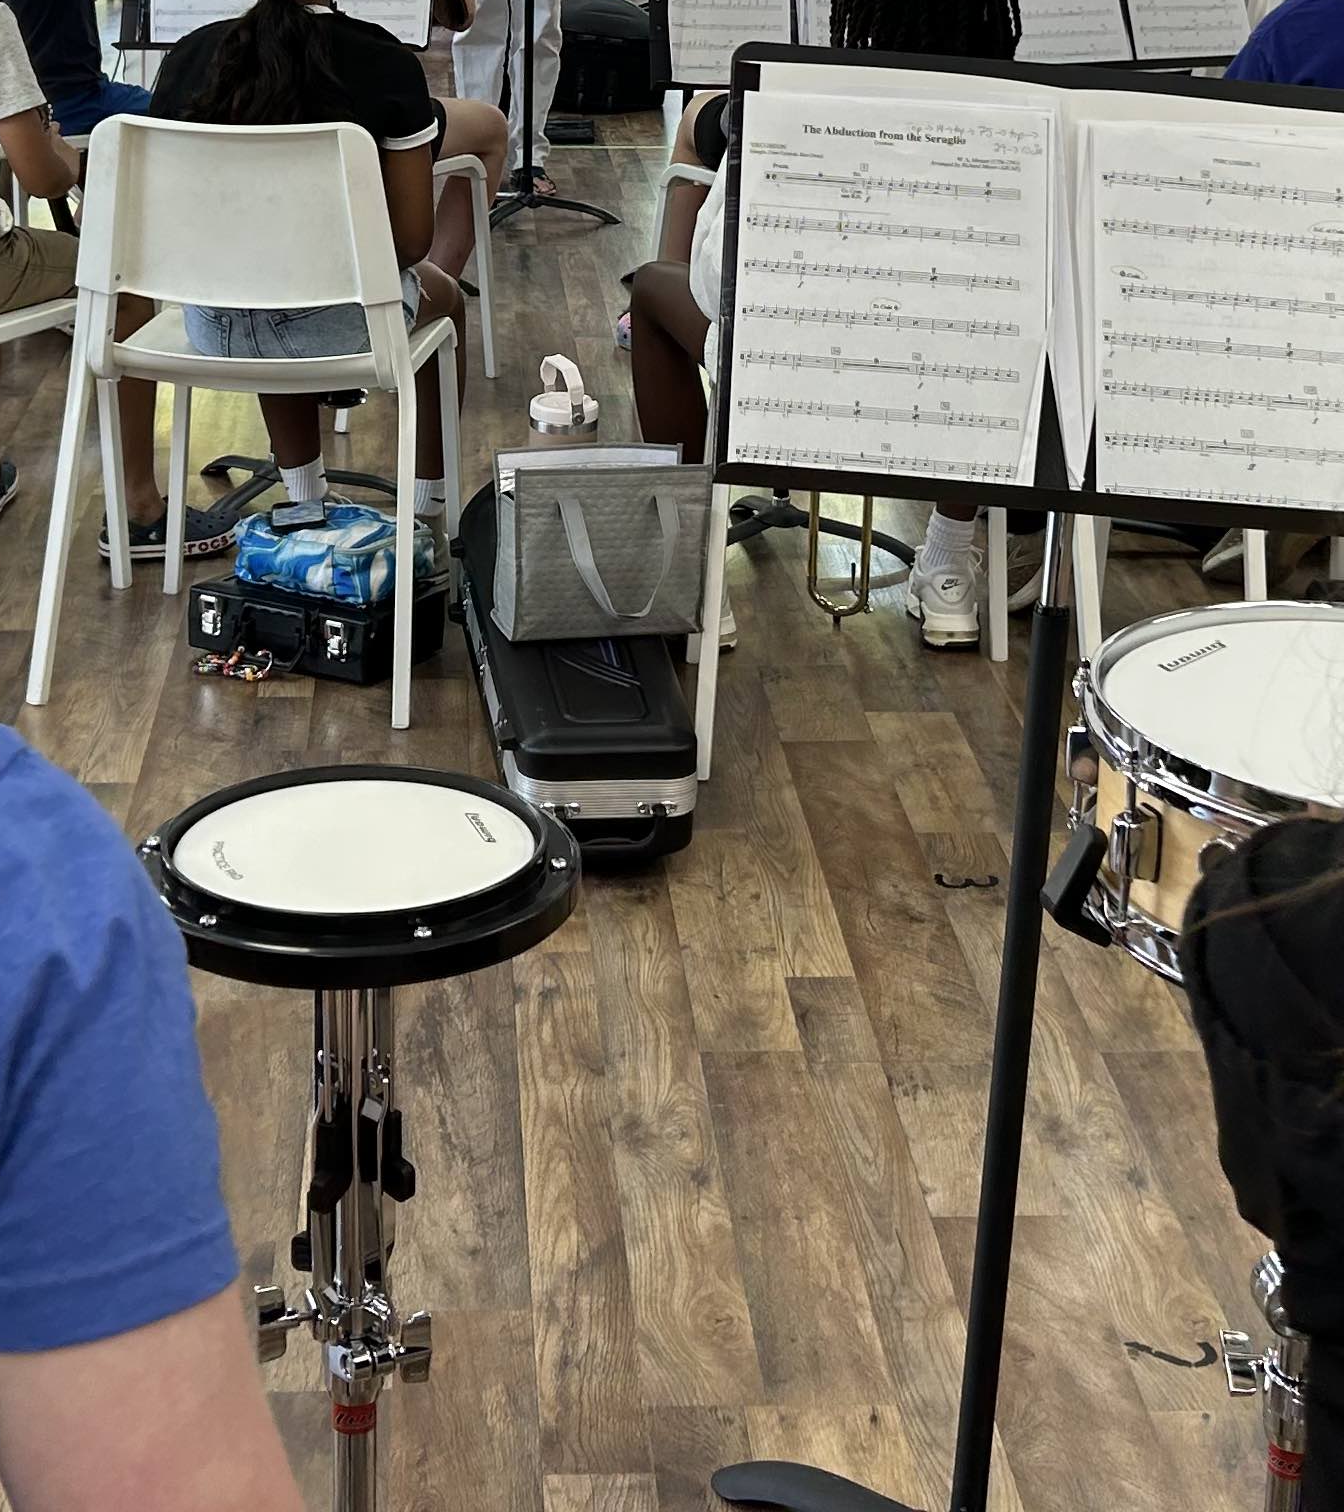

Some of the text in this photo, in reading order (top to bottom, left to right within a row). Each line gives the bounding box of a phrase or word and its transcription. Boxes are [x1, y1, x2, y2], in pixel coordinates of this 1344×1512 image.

[802, 124, 822, 134] The
[824, 125, 876, 139] Abduction
[879, 129, 904, 141] from
[906, 131, 922, 142] the
[183, 535, 229, 554] rocs
